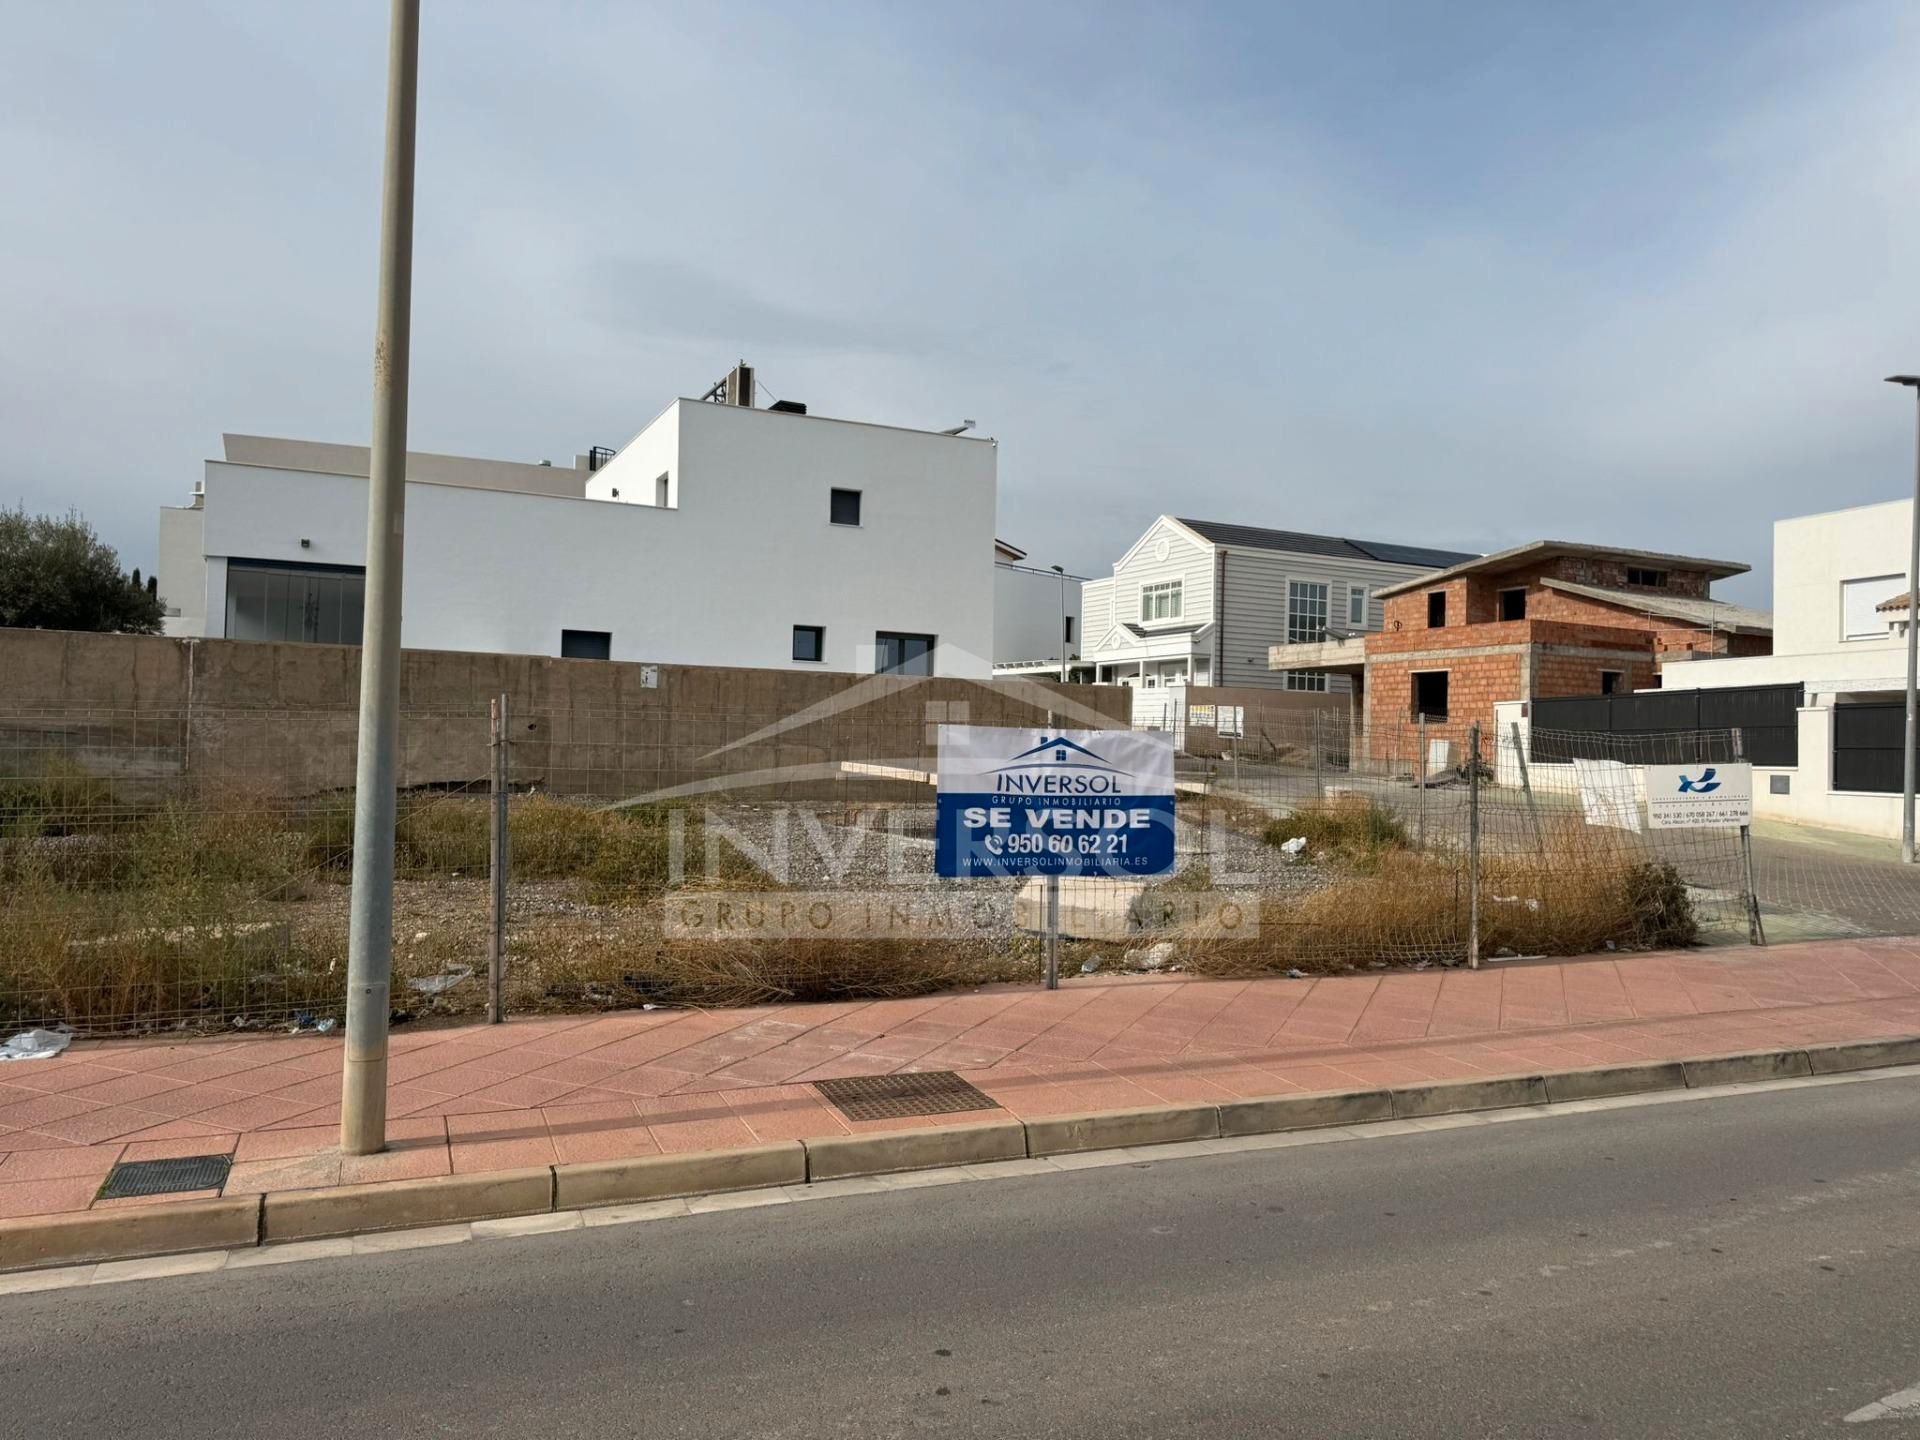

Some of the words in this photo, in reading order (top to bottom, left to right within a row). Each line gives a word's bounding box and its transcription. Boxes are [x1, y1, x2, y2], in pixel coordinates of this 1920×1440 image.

[997, 773, 1121, 793] INVERSOL
[992, 796, 1032, 805] GRUPO
[1039, 797, 1120, 806] INMOBILIARIO
[963, 807, 1011, 828] SE
[1025, 808, 1150, 829] VENDE
[1008, 833, 1043, 853] 950
[1048, 834, 1073, 853] 60
[1078, 834, 1101, 854] 62
[1106, 834, 1127, 853] 21
[963, 857, 1149, 866] WWW.INVERSOLINMOBILIARIA.ES
